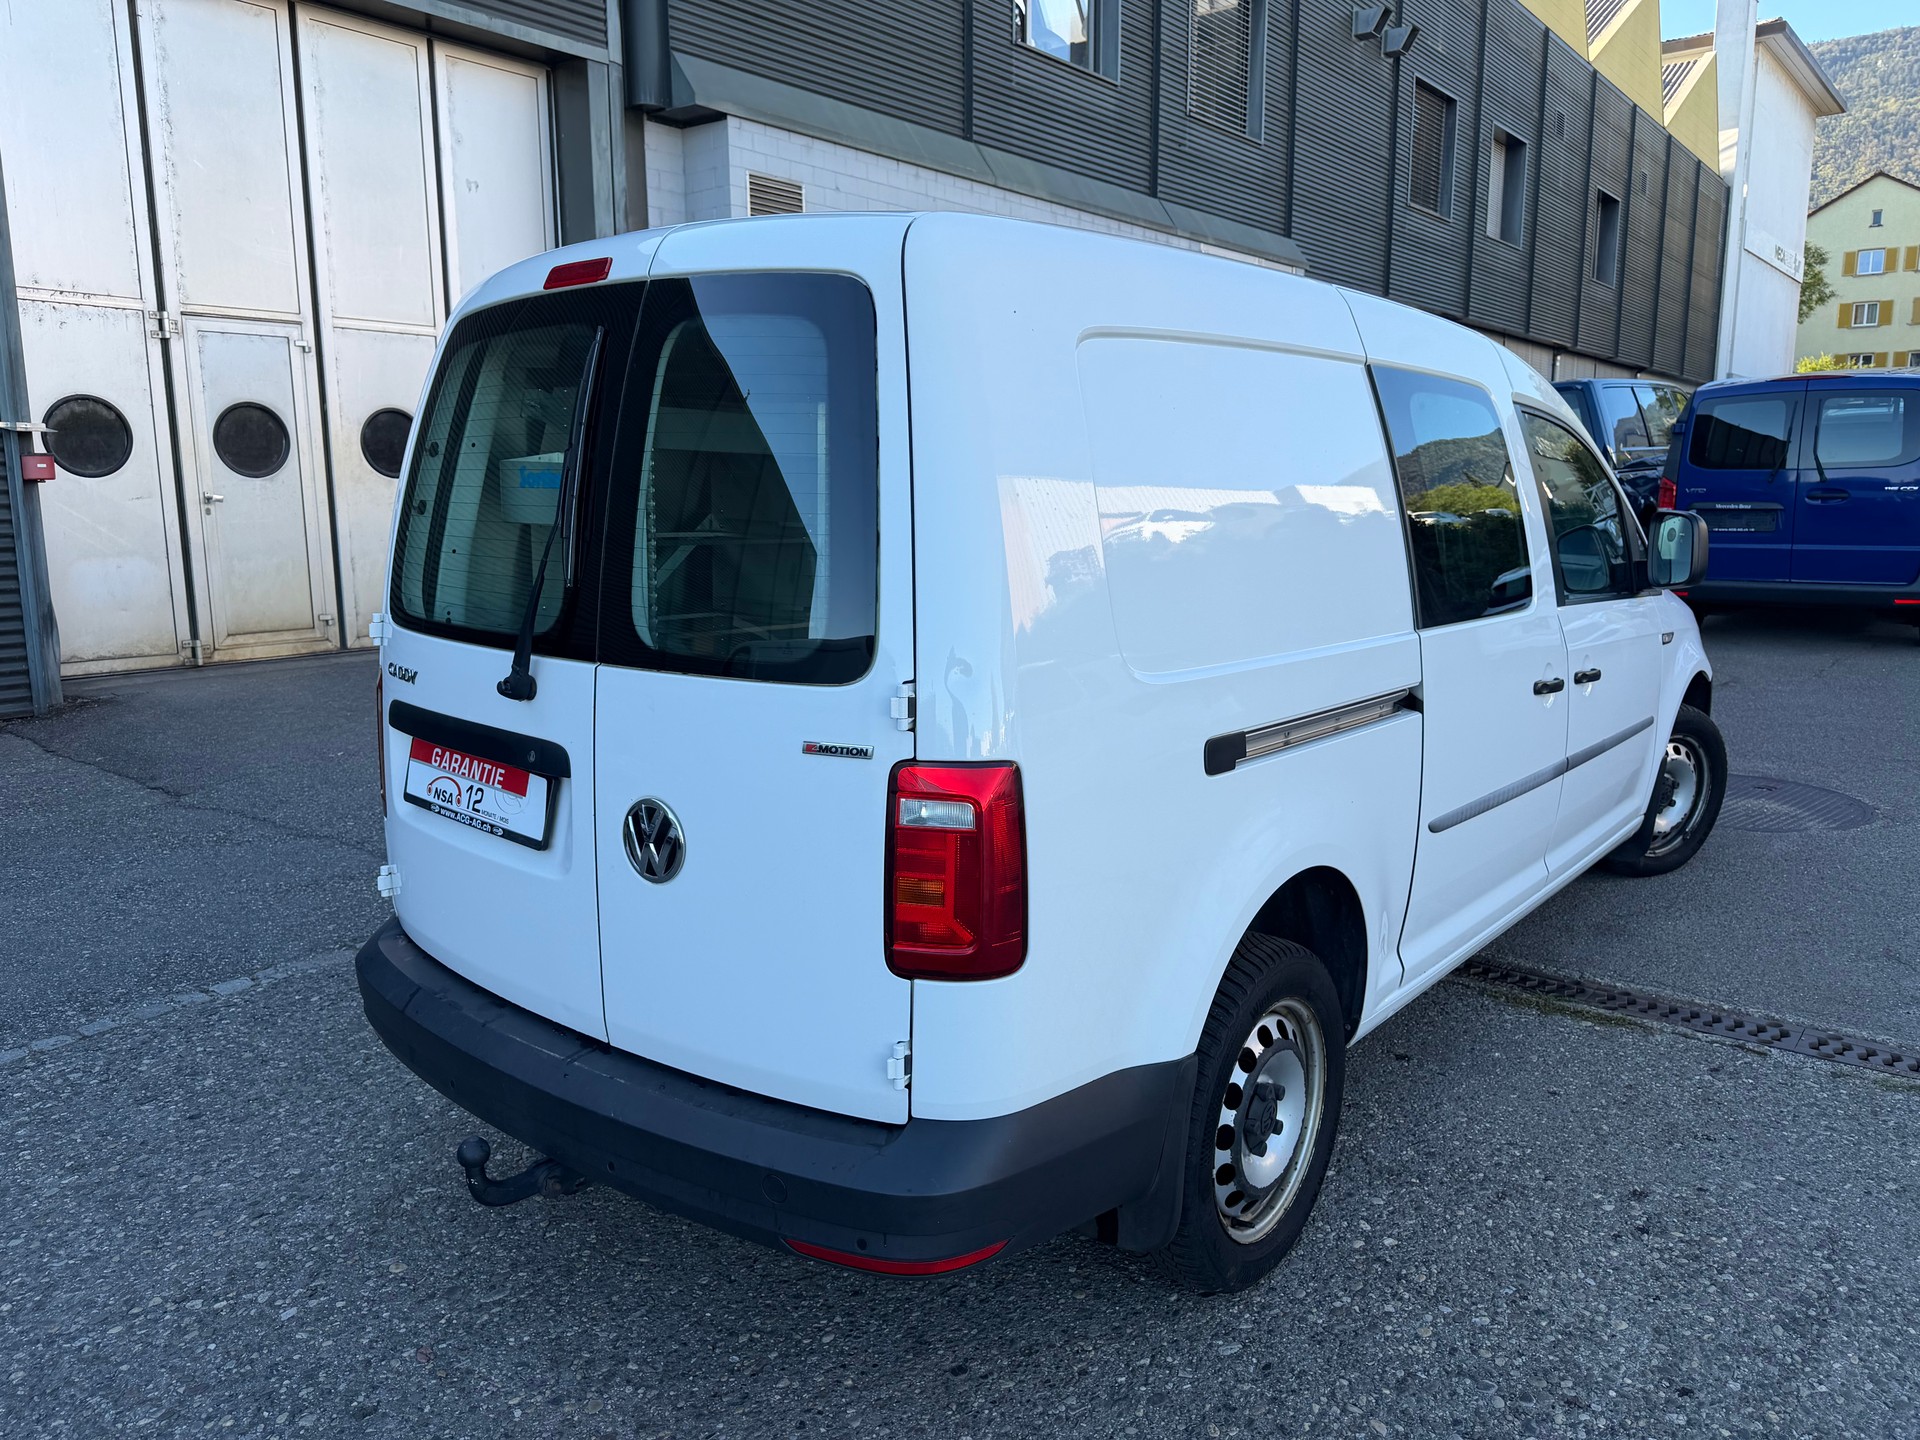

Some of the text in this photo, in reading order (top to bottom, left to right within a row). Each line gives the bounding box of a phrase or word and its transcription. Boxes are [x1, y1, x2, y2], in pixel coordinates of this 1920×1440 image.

[1715, 502, 1752, 510] Mercedes-Benz
[389, 662, 418, 685] CADDY
[432, 748, 505, 789] GARANTIE
[433, 787, 453, 806] NSA
[465, 785, 484, 814] 12
[440, 807, 492, 833] www.ACG-AG.ch
